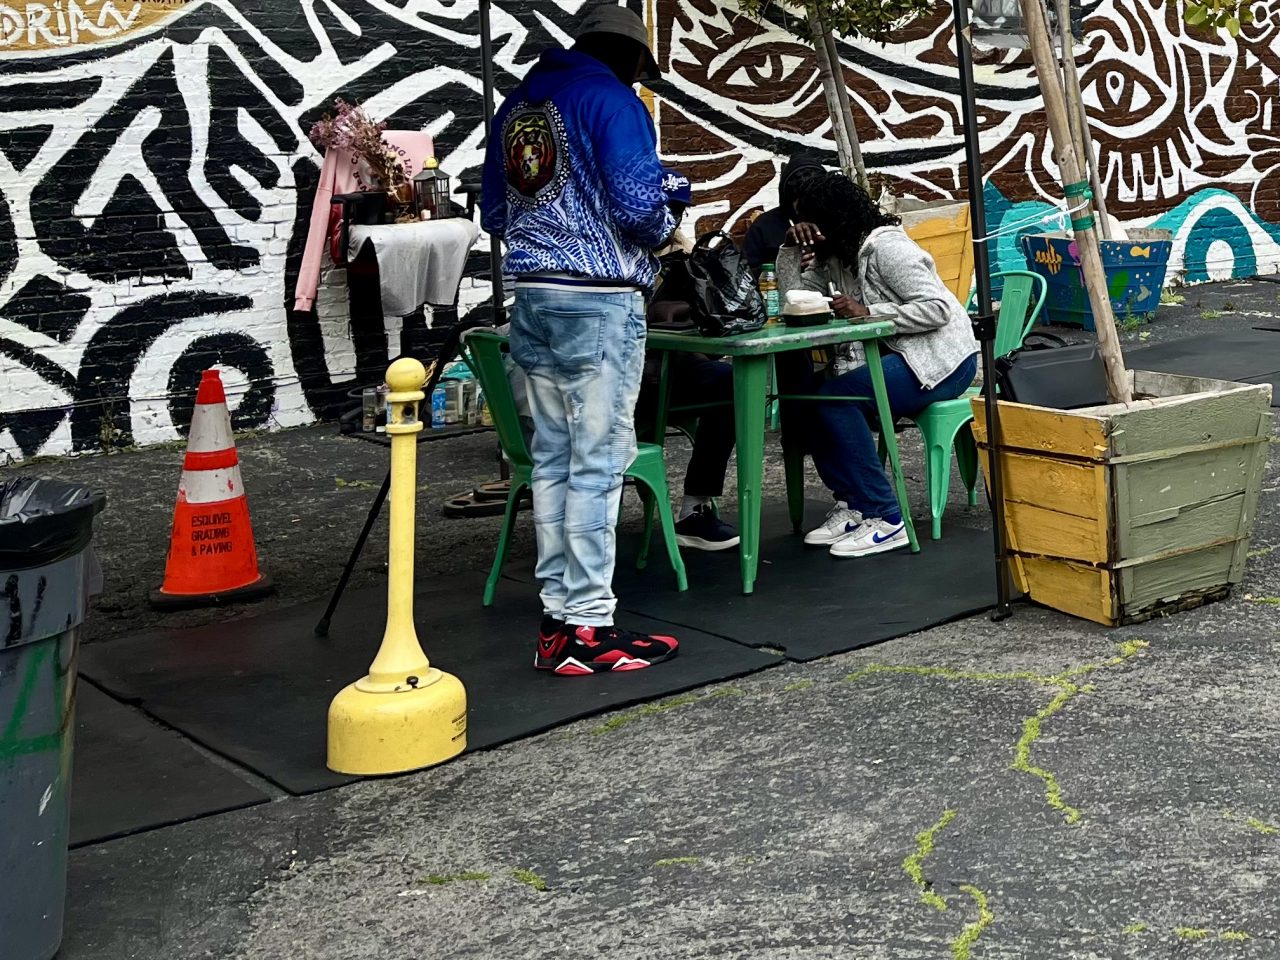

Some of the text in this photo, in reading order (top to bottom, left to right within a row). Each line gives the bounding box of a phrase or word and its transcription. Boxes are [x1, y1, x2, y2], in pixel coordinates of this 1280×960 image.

[191, 512, 233, 527] ESQUIVEL
[191, 527, 230, 541] GRADING
[191, 541, 233, 557] & PAVING
